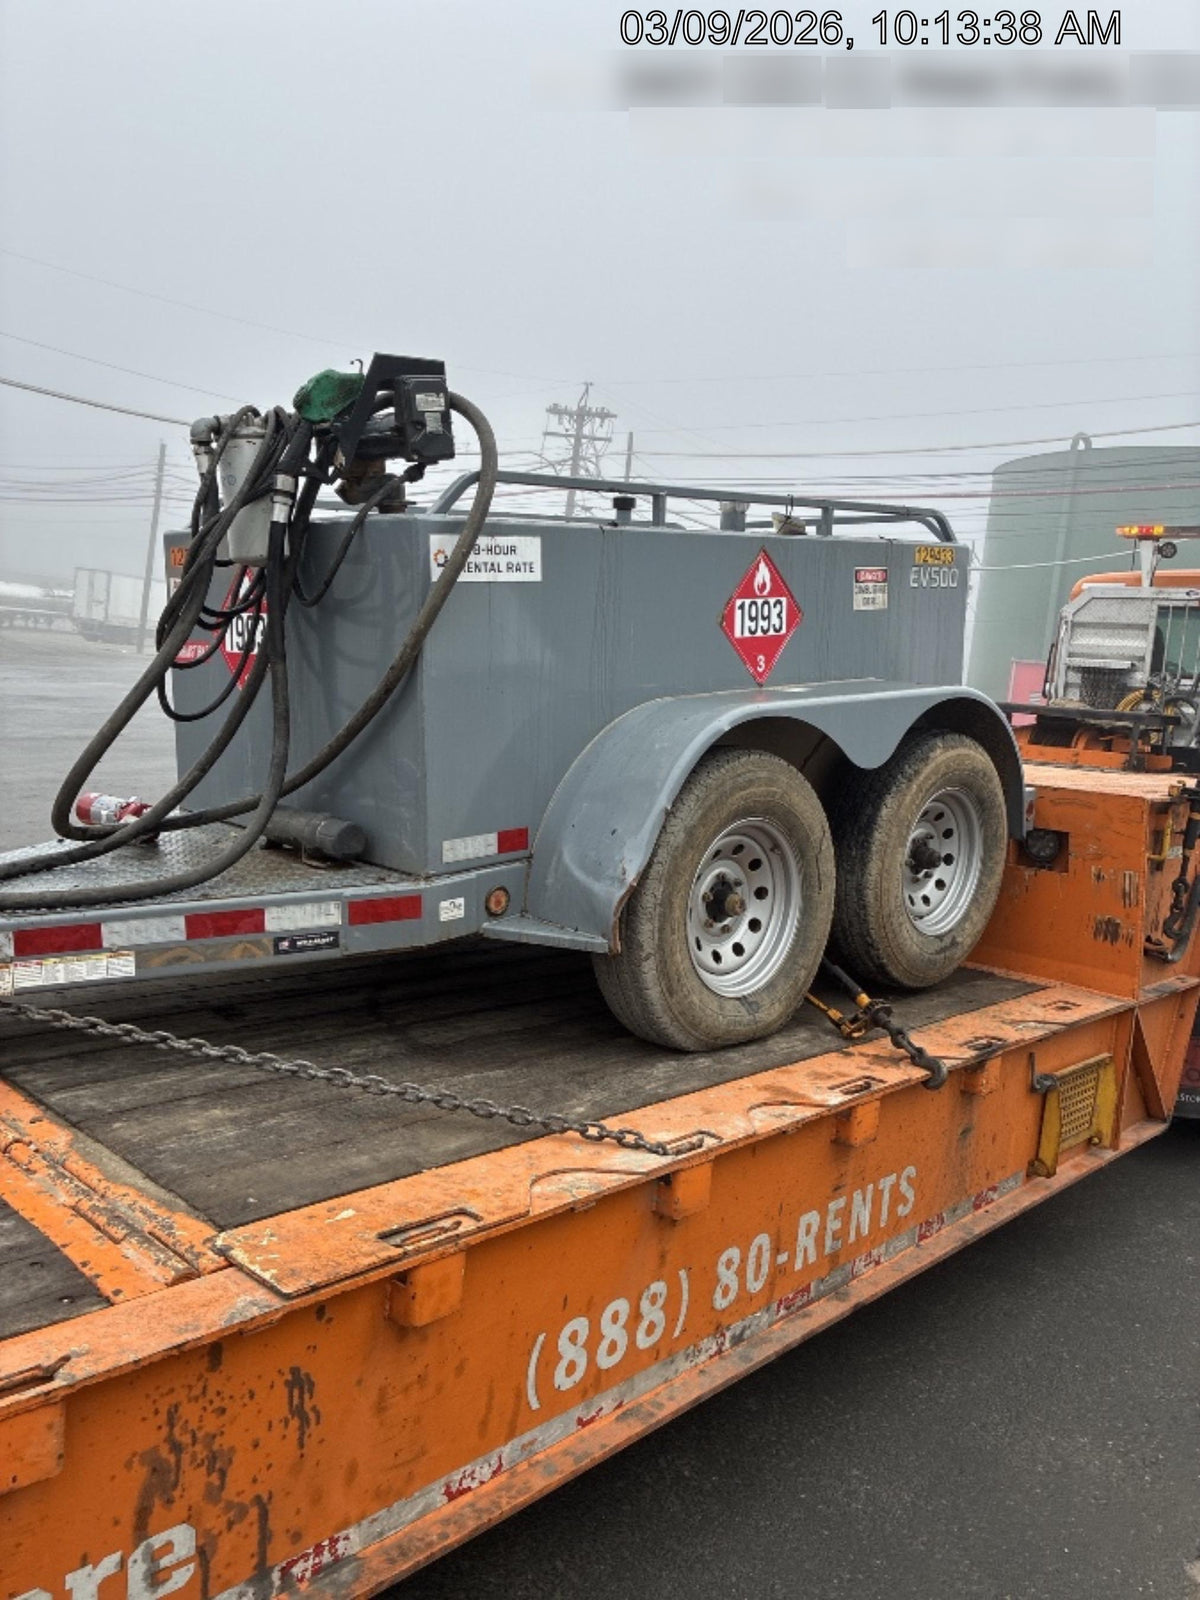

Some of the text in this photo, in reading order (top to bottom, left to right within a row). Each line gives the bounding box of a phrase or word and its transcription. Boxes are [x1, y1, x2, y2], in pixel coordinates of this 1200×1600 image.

[506, 562, 535, 573] RATE
[737, 598, 784, 637] 1993
[756, 655, 765, 672] 3
[526, 1165, 917, 1411] (888) 80-RENTS
